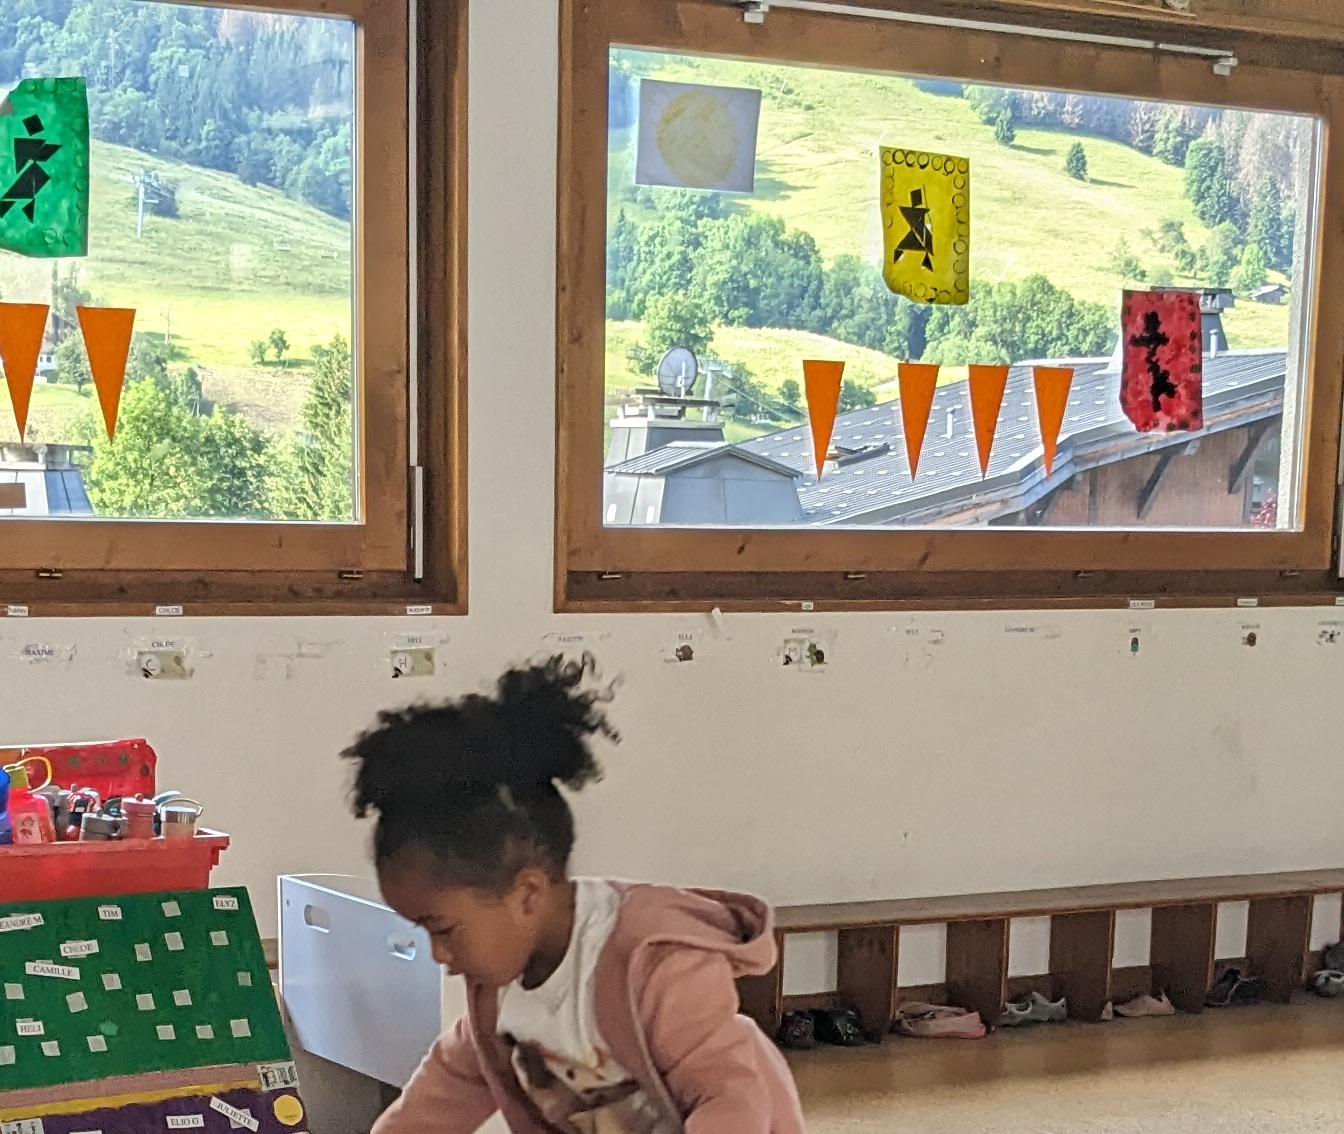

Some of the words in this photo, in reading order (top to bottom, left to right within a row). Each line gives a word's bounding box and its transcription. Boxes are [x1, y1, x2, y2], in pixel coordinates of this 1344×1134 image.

[102, 909, 119, 918] TIM
[217, 1102, 253, 1127] JULIETTE
[171, 1117, 191, 1126] ELIO
